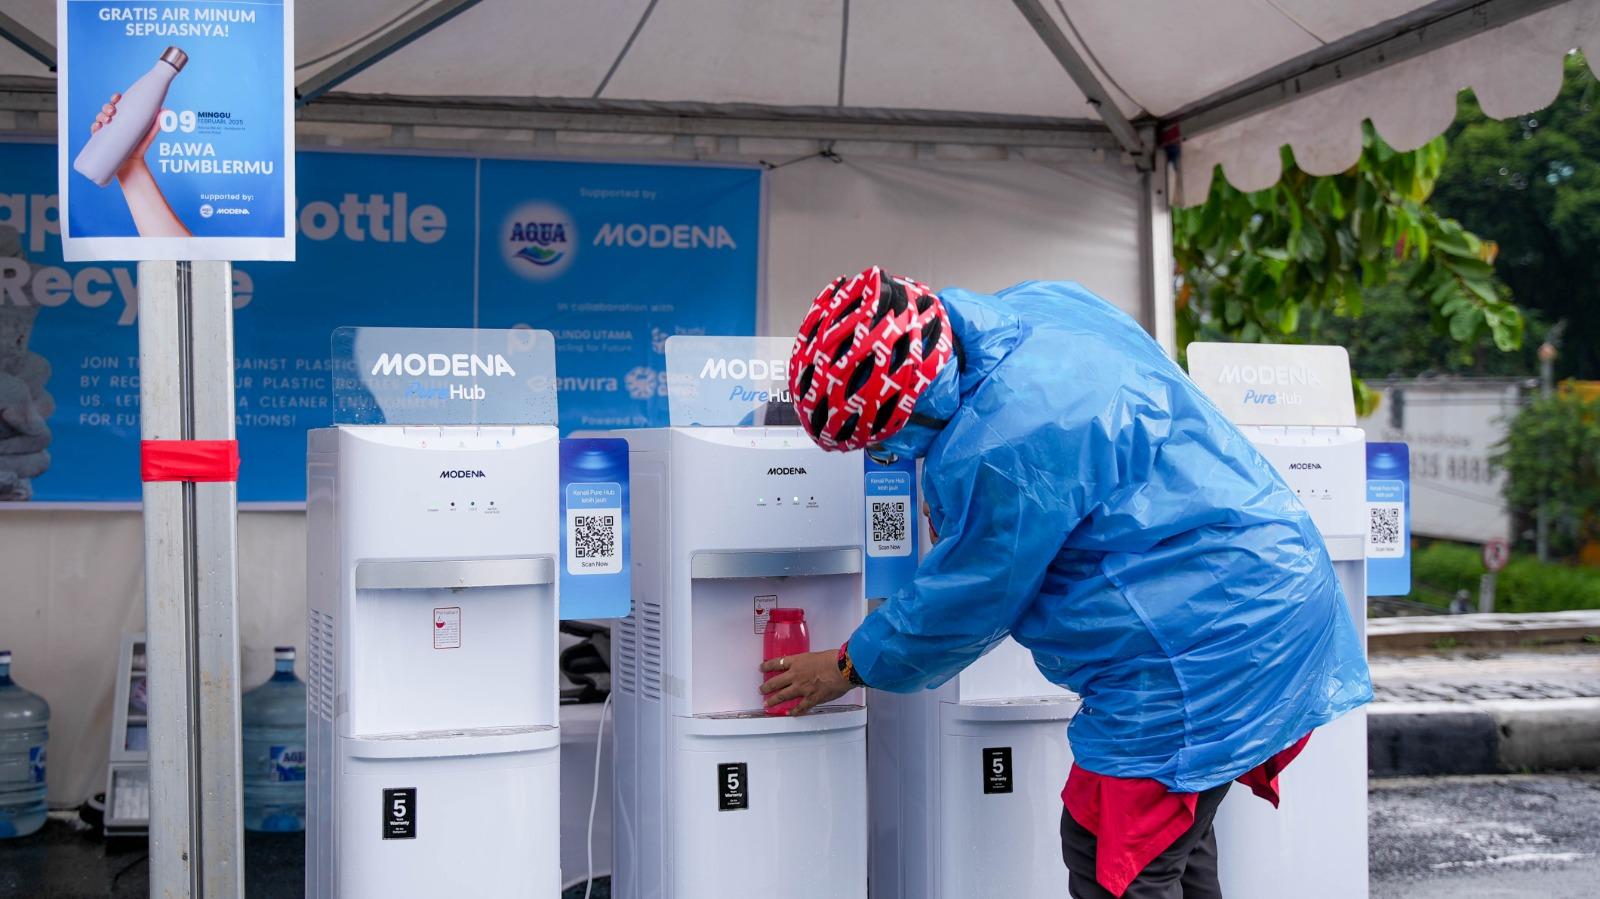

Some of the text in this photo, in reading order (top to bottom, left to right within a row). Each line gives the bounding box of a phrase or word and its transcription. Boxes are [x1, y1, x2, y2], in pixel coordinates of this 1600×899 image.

[99, 8, 256, 23] GRATIS AIR MINUM
[125, 23, 229, 37] SEPUASNYA!
[159, 110, 196, 133] 09
[159, 142, 216, 157] BAWA
[159, 159, 274, 175] TUMBLERMU
[200, 193, 240, 201] supported
[580, 187, 657, 200] Supported by
[294, 191, 447, 244] ottle
[510, 223, 567, 246] AQUA
[593, 223, 737, 249] MODENA
[651, 303, 674, 312] with
[593, 330, 632, 340] UTAMA
[80, 357, 119, 369] JOIN
[371, 353, 516, 377] MODENA
[700, 358, 790, 380] MODE
[80, 375, 100, 388] BY
[1218, 365, 1321, 386] MODENA
[263, 377, 324, 390] PLASTIC
[239, 396, 249, 408] A
[259, 396, 328, 409] CLEANER
[79, 413, 111, 426] FOR
[440, 470, 486, 479] MODENA
[992, 758, 1004, 773] 5
[727, 773, 739, 789] 5
[393, 799, 406, 817] 5
